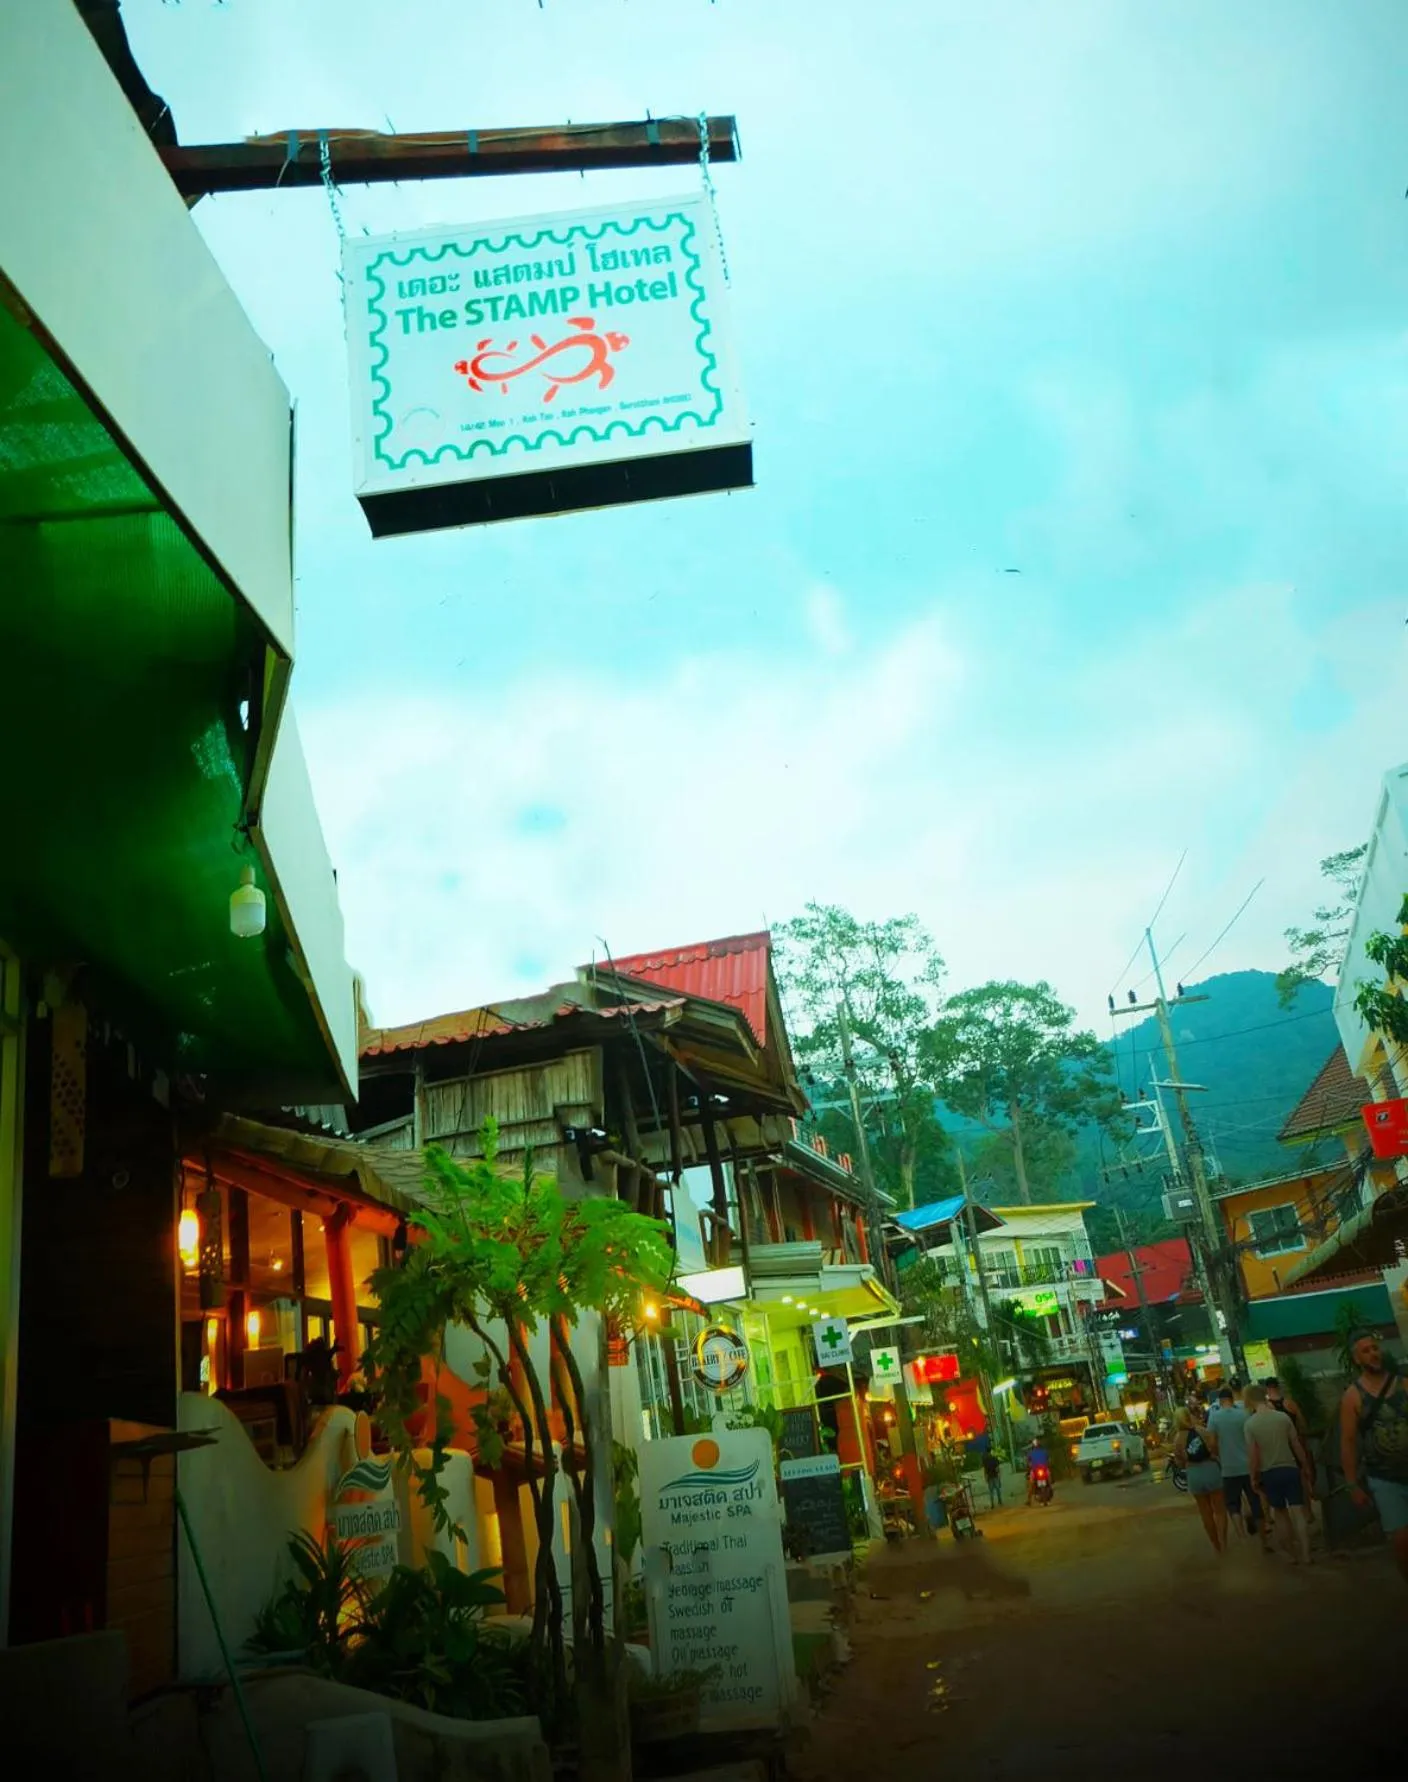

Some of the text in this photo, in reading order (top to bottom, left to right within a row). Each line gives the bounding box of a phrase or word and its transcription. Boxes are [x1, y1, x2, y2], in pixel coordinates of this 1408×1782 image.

[585, 243, 672, 272] โฮเทล
[395, 271, 678, 335] The STAMP Hotel
[671, 1504, 752, 1527] Majestic SPA
[722, 1534, 747, 1549] Thai
[668, 1600, 714, 1619] Swedish
[670, 1625, 717, 1642] massage
